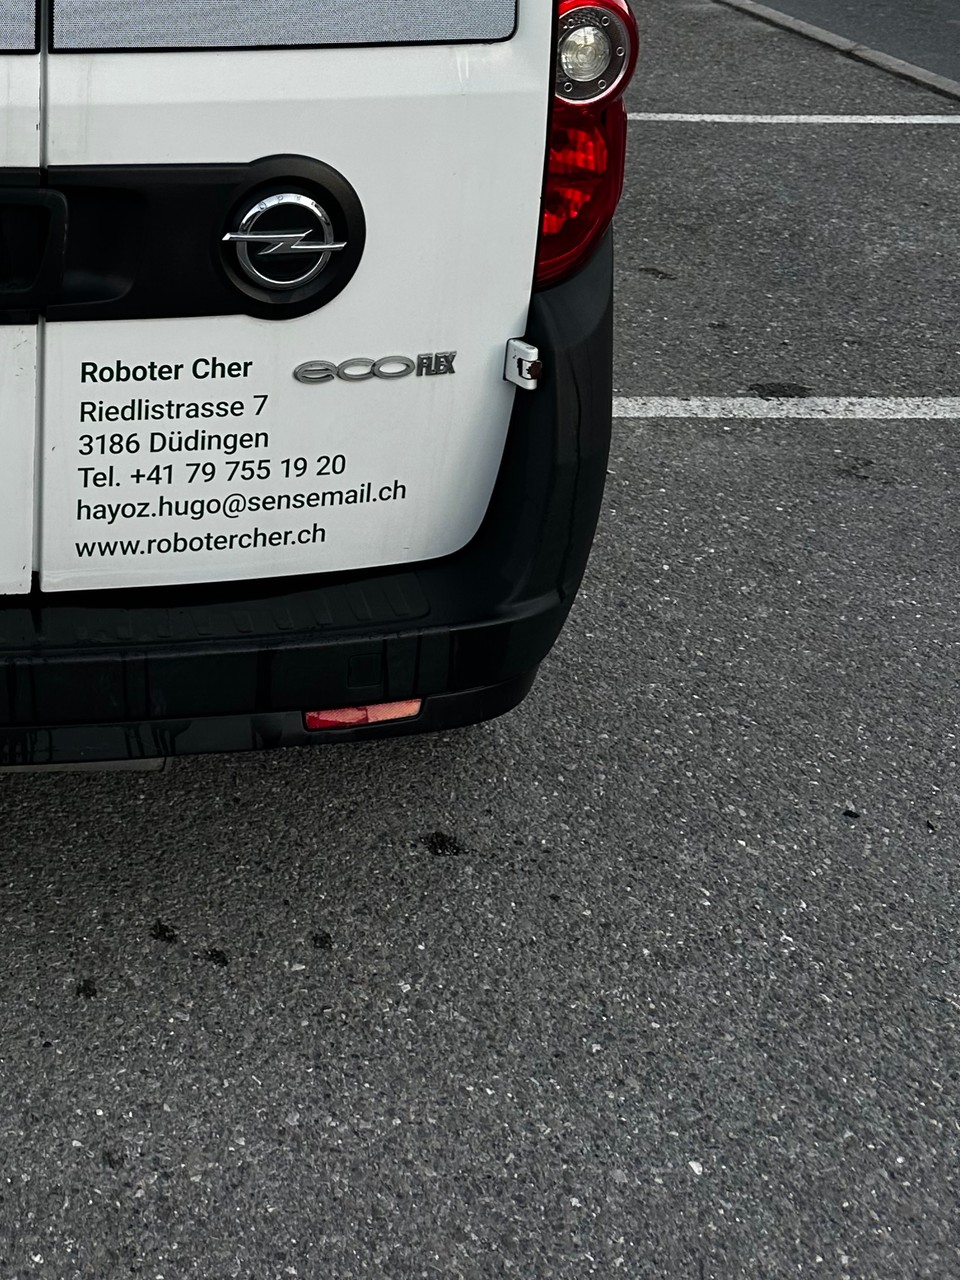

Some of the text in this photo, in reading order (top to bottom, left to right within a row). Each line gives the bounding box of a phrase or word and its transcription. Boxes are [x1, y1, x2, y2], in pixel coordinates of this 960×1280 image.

[80, 357, 253, 383] Roboter Cher
[80, 395, 269, 422] Riedlistrasse 7
[78, 428, 269, 456] 3186 Düdingen
[78, 454, 347, 489] Tel. +41 79 755 19 20
[76, 480, 407, 524] hayoz.hugo@sensemail.ch
[75, 523, 327, 558] www.robotercher.ch
